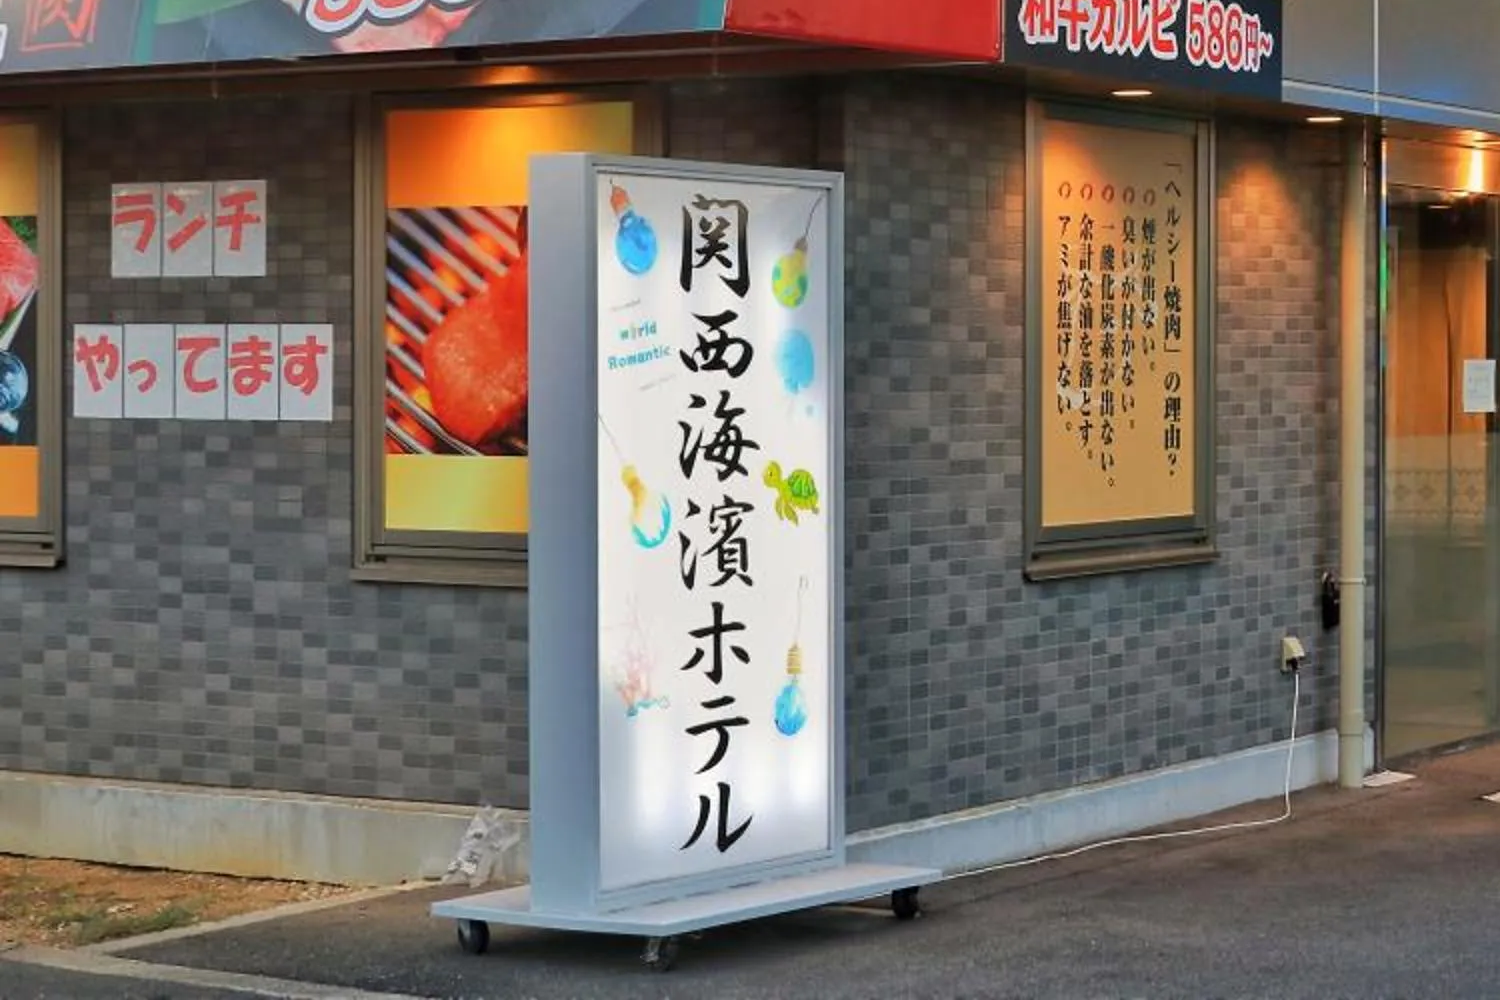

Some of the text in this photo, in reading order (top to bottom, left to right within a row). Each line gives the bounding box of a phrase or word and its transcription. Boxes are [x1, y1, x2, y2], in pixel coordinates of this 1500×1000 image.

[113, 191, 261, 253] ランチ
[76, 335, 328, 396] やってます
[678, 193, 760, 854] 関西海濱ホテル
